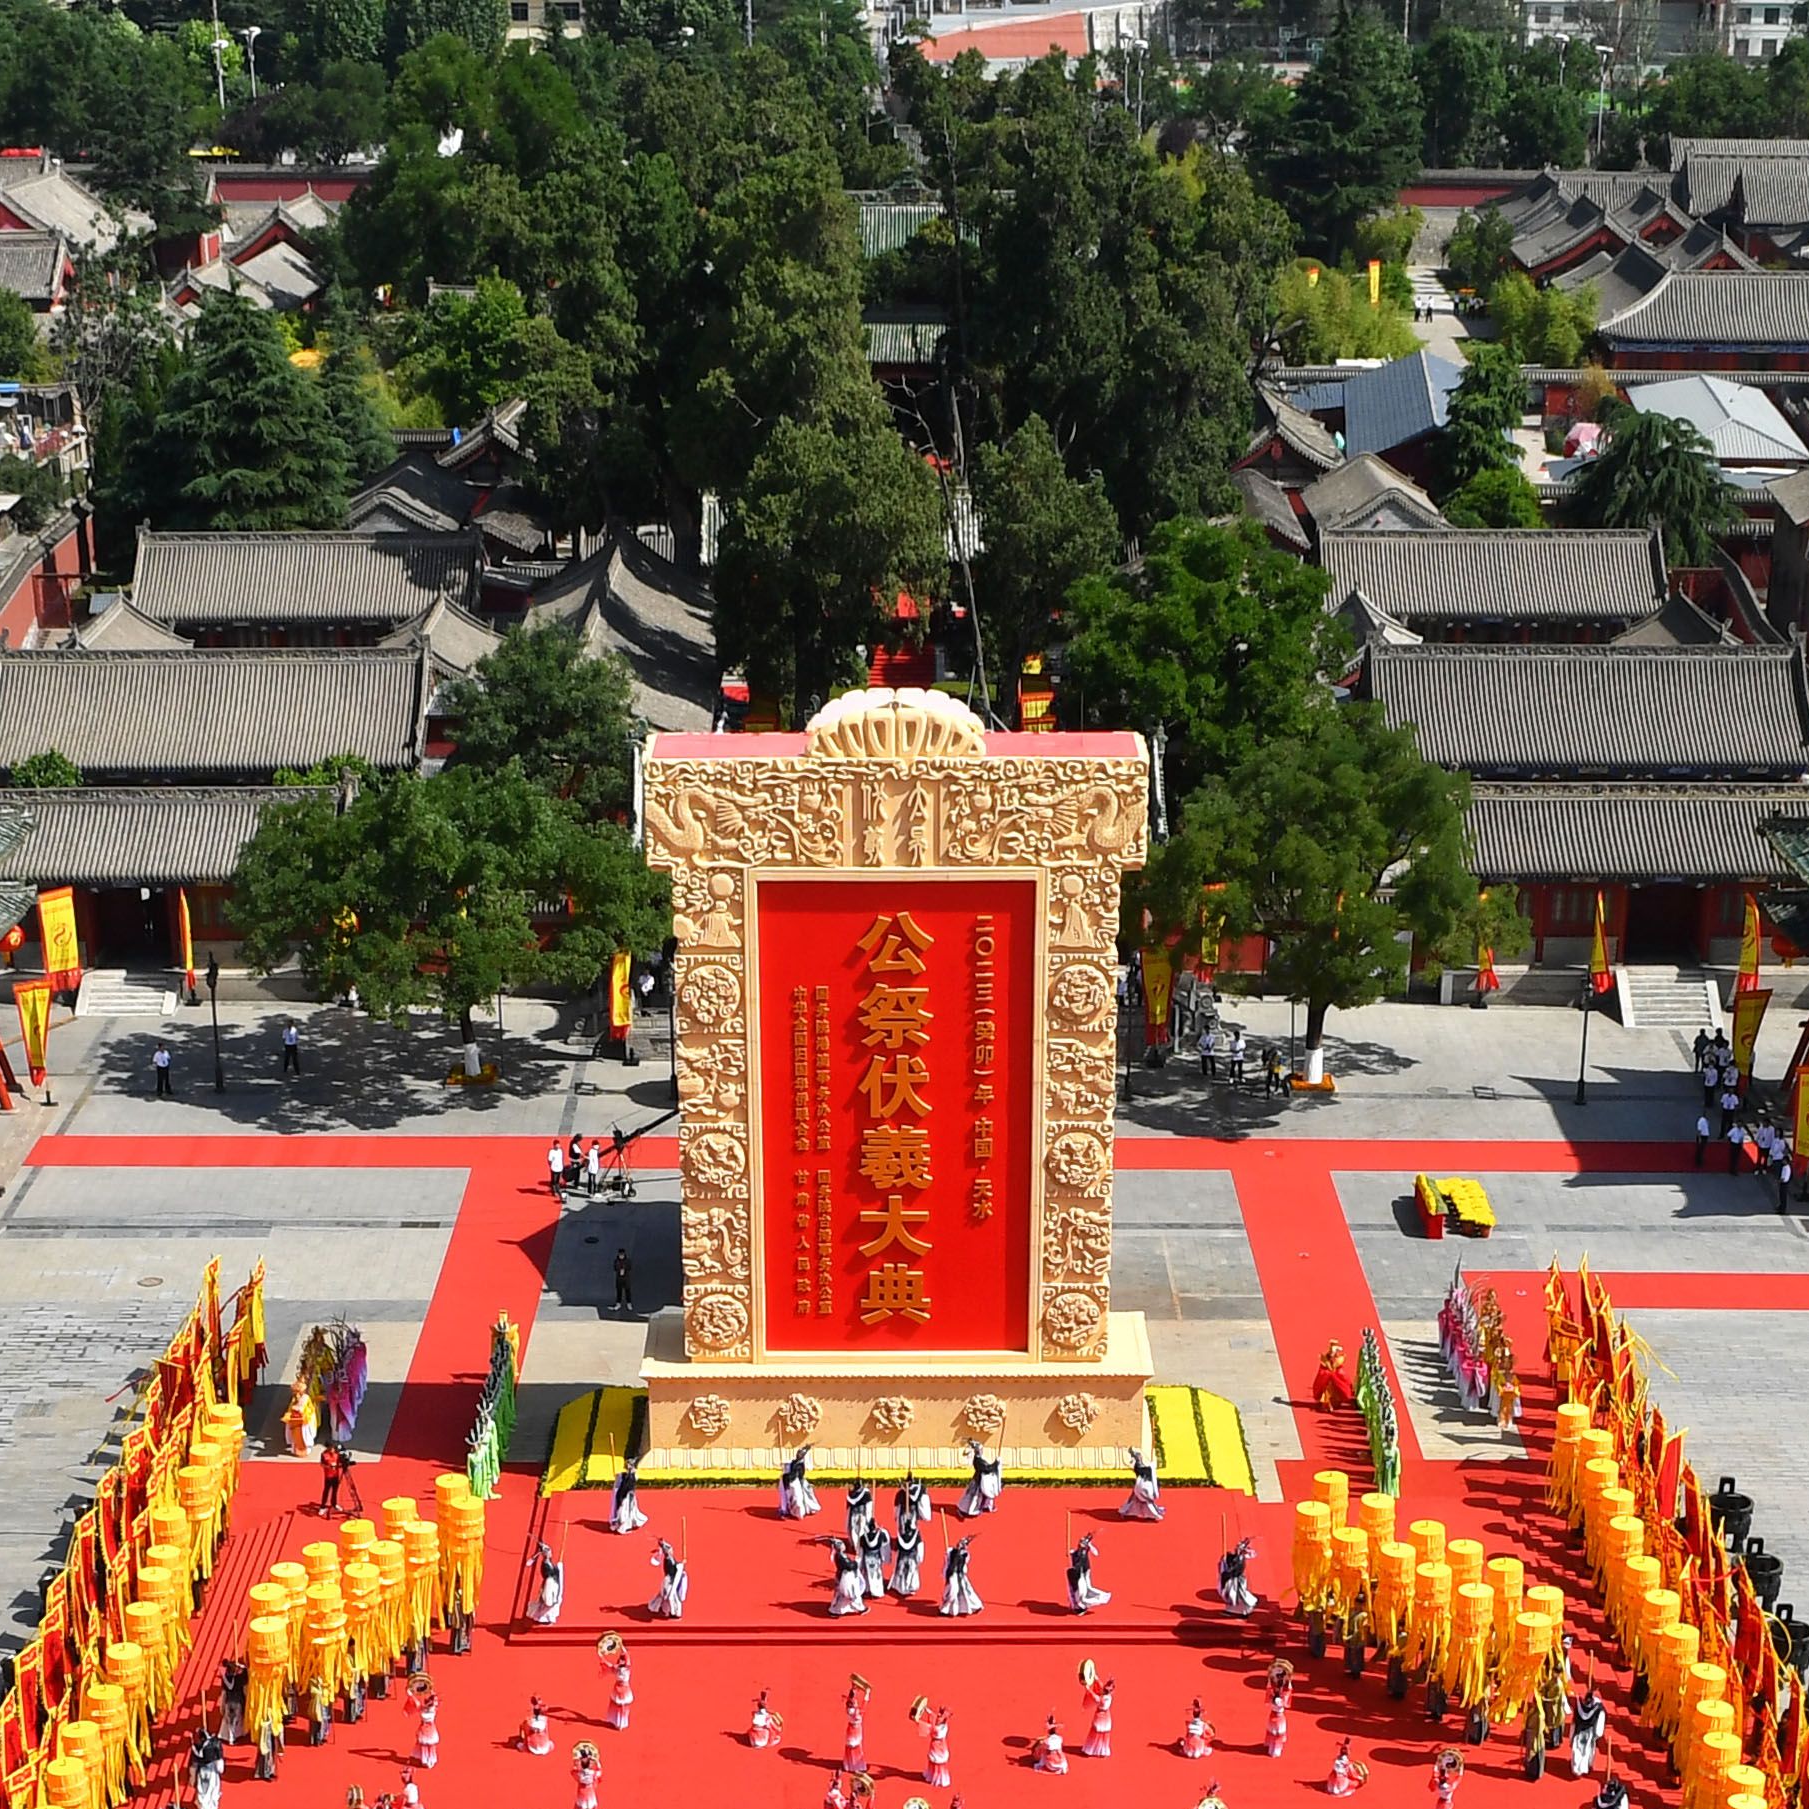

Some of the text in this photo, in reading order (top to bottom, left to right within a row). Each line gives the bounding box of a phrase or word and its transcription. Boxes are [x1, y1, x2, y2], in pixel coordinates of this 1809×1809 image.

[795, 1169, 812, 1313] 甘肃省人民政府
[857, 911, 934, 1323] 公祭伏羲大典
